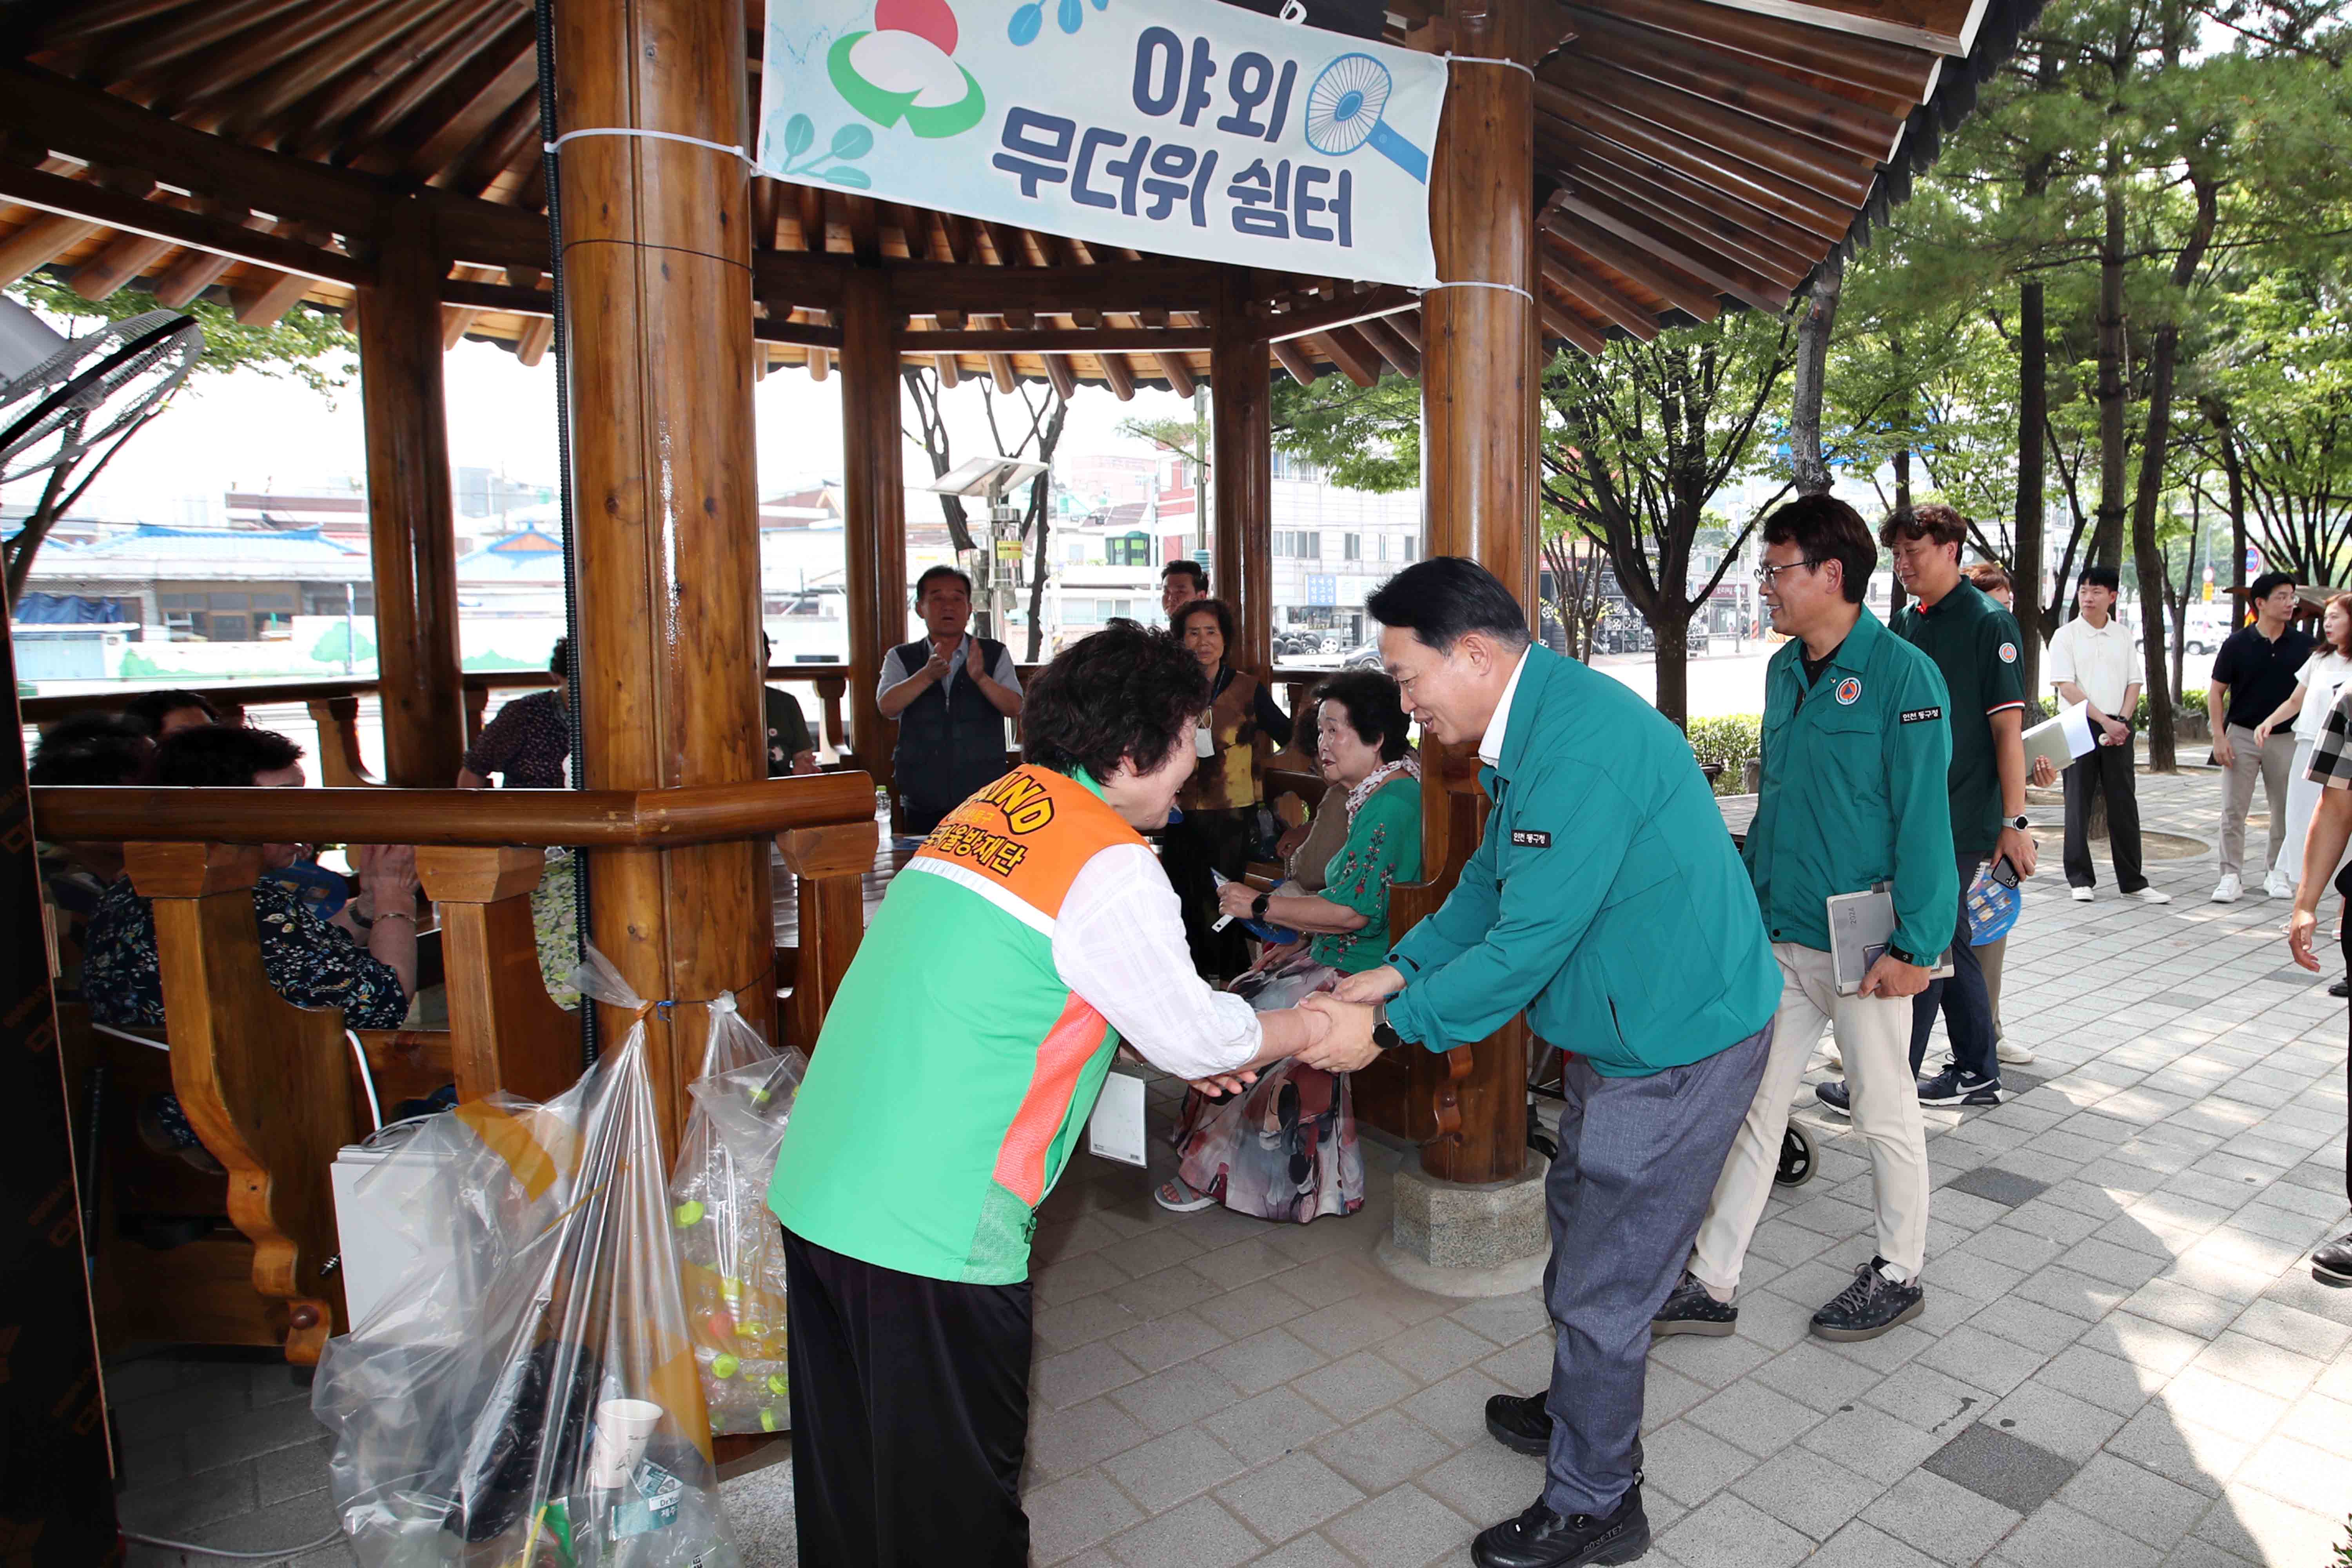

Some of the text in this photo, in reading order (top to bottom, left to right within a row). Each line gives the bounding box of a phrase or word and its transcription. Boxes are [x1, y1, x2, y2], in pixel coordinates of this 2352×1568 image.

[1132, 26, 1298, 143] 야외
[992, 106, 1353, 248] 무더위 쉼터
[1902, 708, 1938, 722] 인천 동구청
[1513, 832, 1546, 844] 인천 동구청
